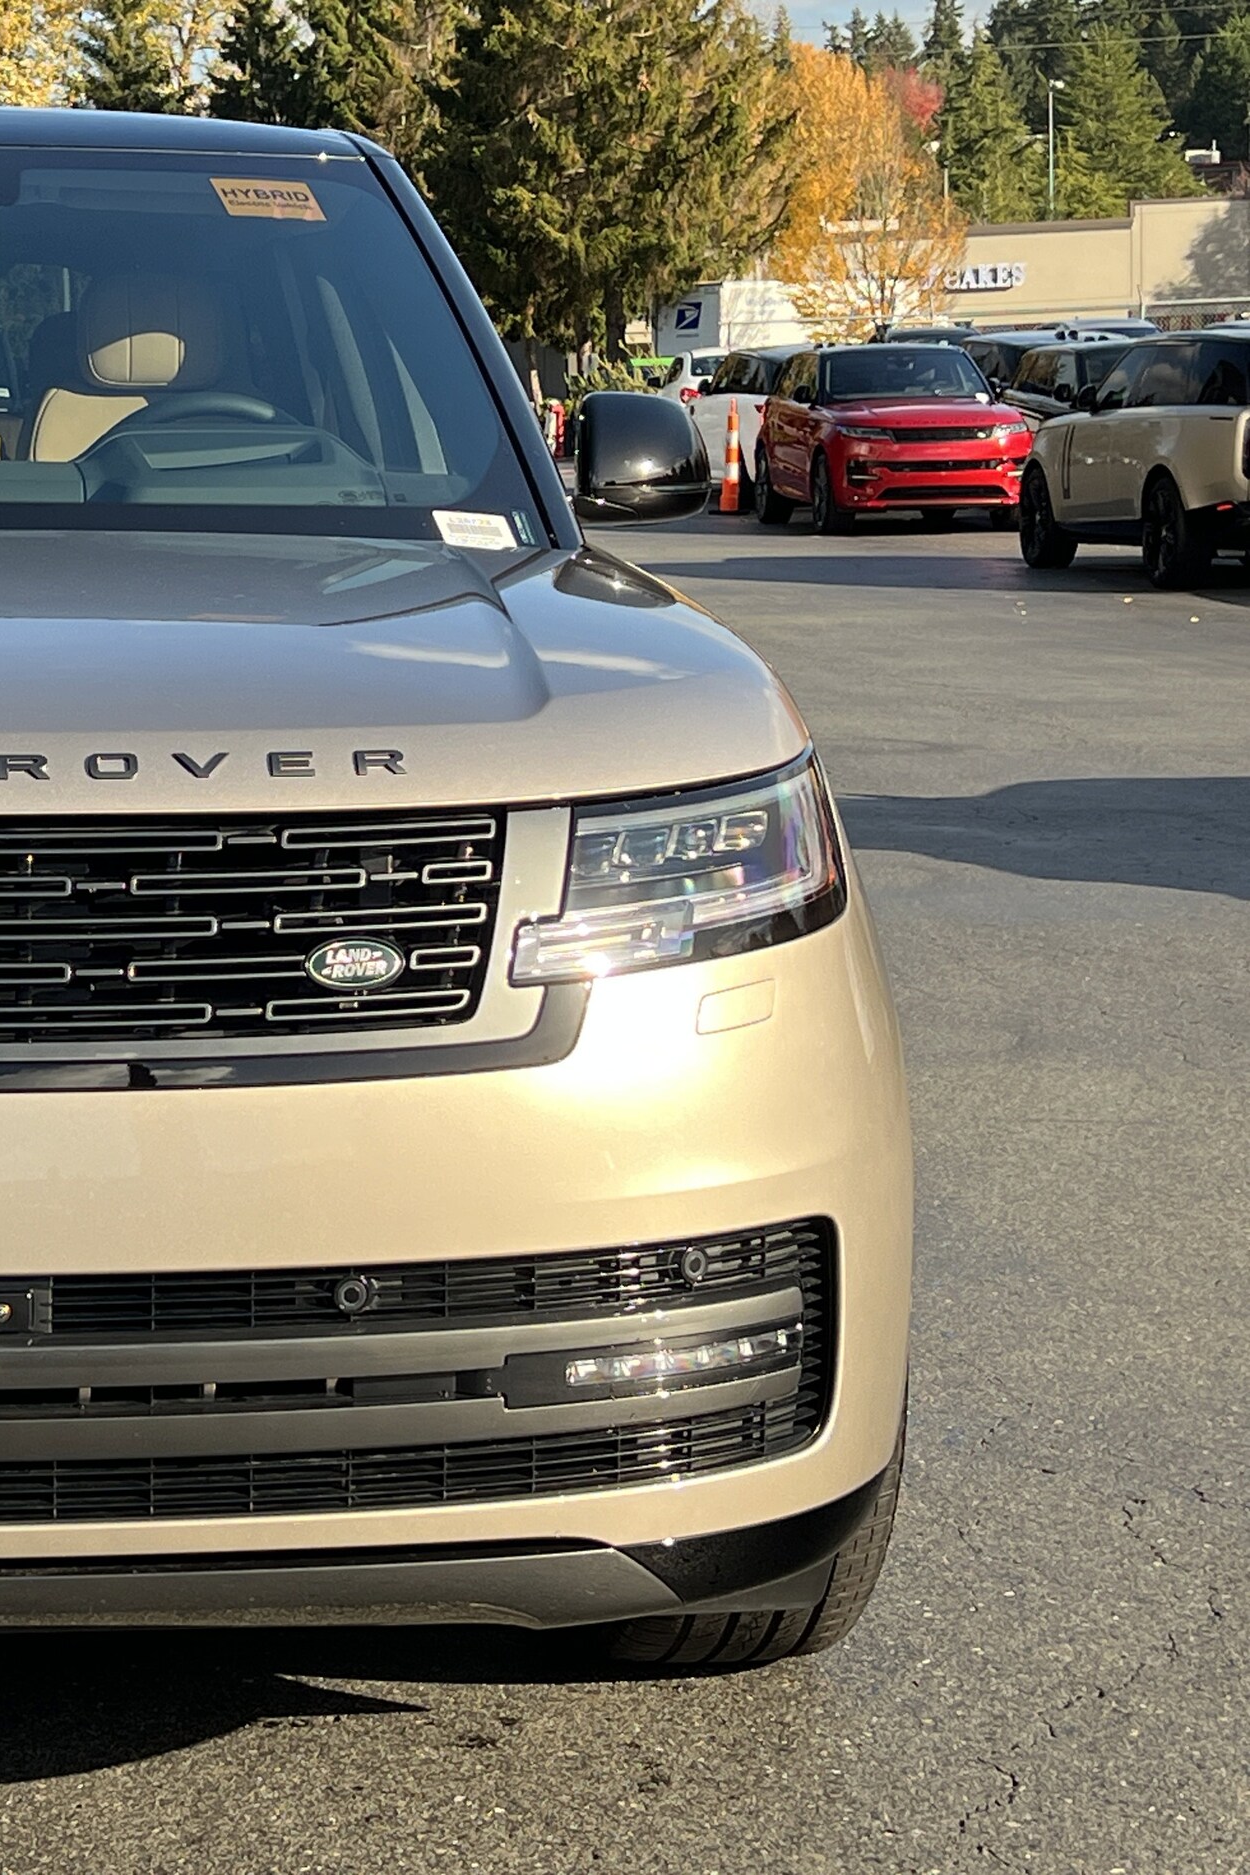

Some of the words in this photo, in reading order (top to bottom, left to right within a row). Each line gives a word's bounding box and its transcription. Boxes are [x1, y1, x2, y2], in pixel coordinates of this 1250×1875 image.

[220, 187, 310, 202] HYBRID
[325, 948, 372, 965] LAND
[331, 959, 388, 979] ROVER
